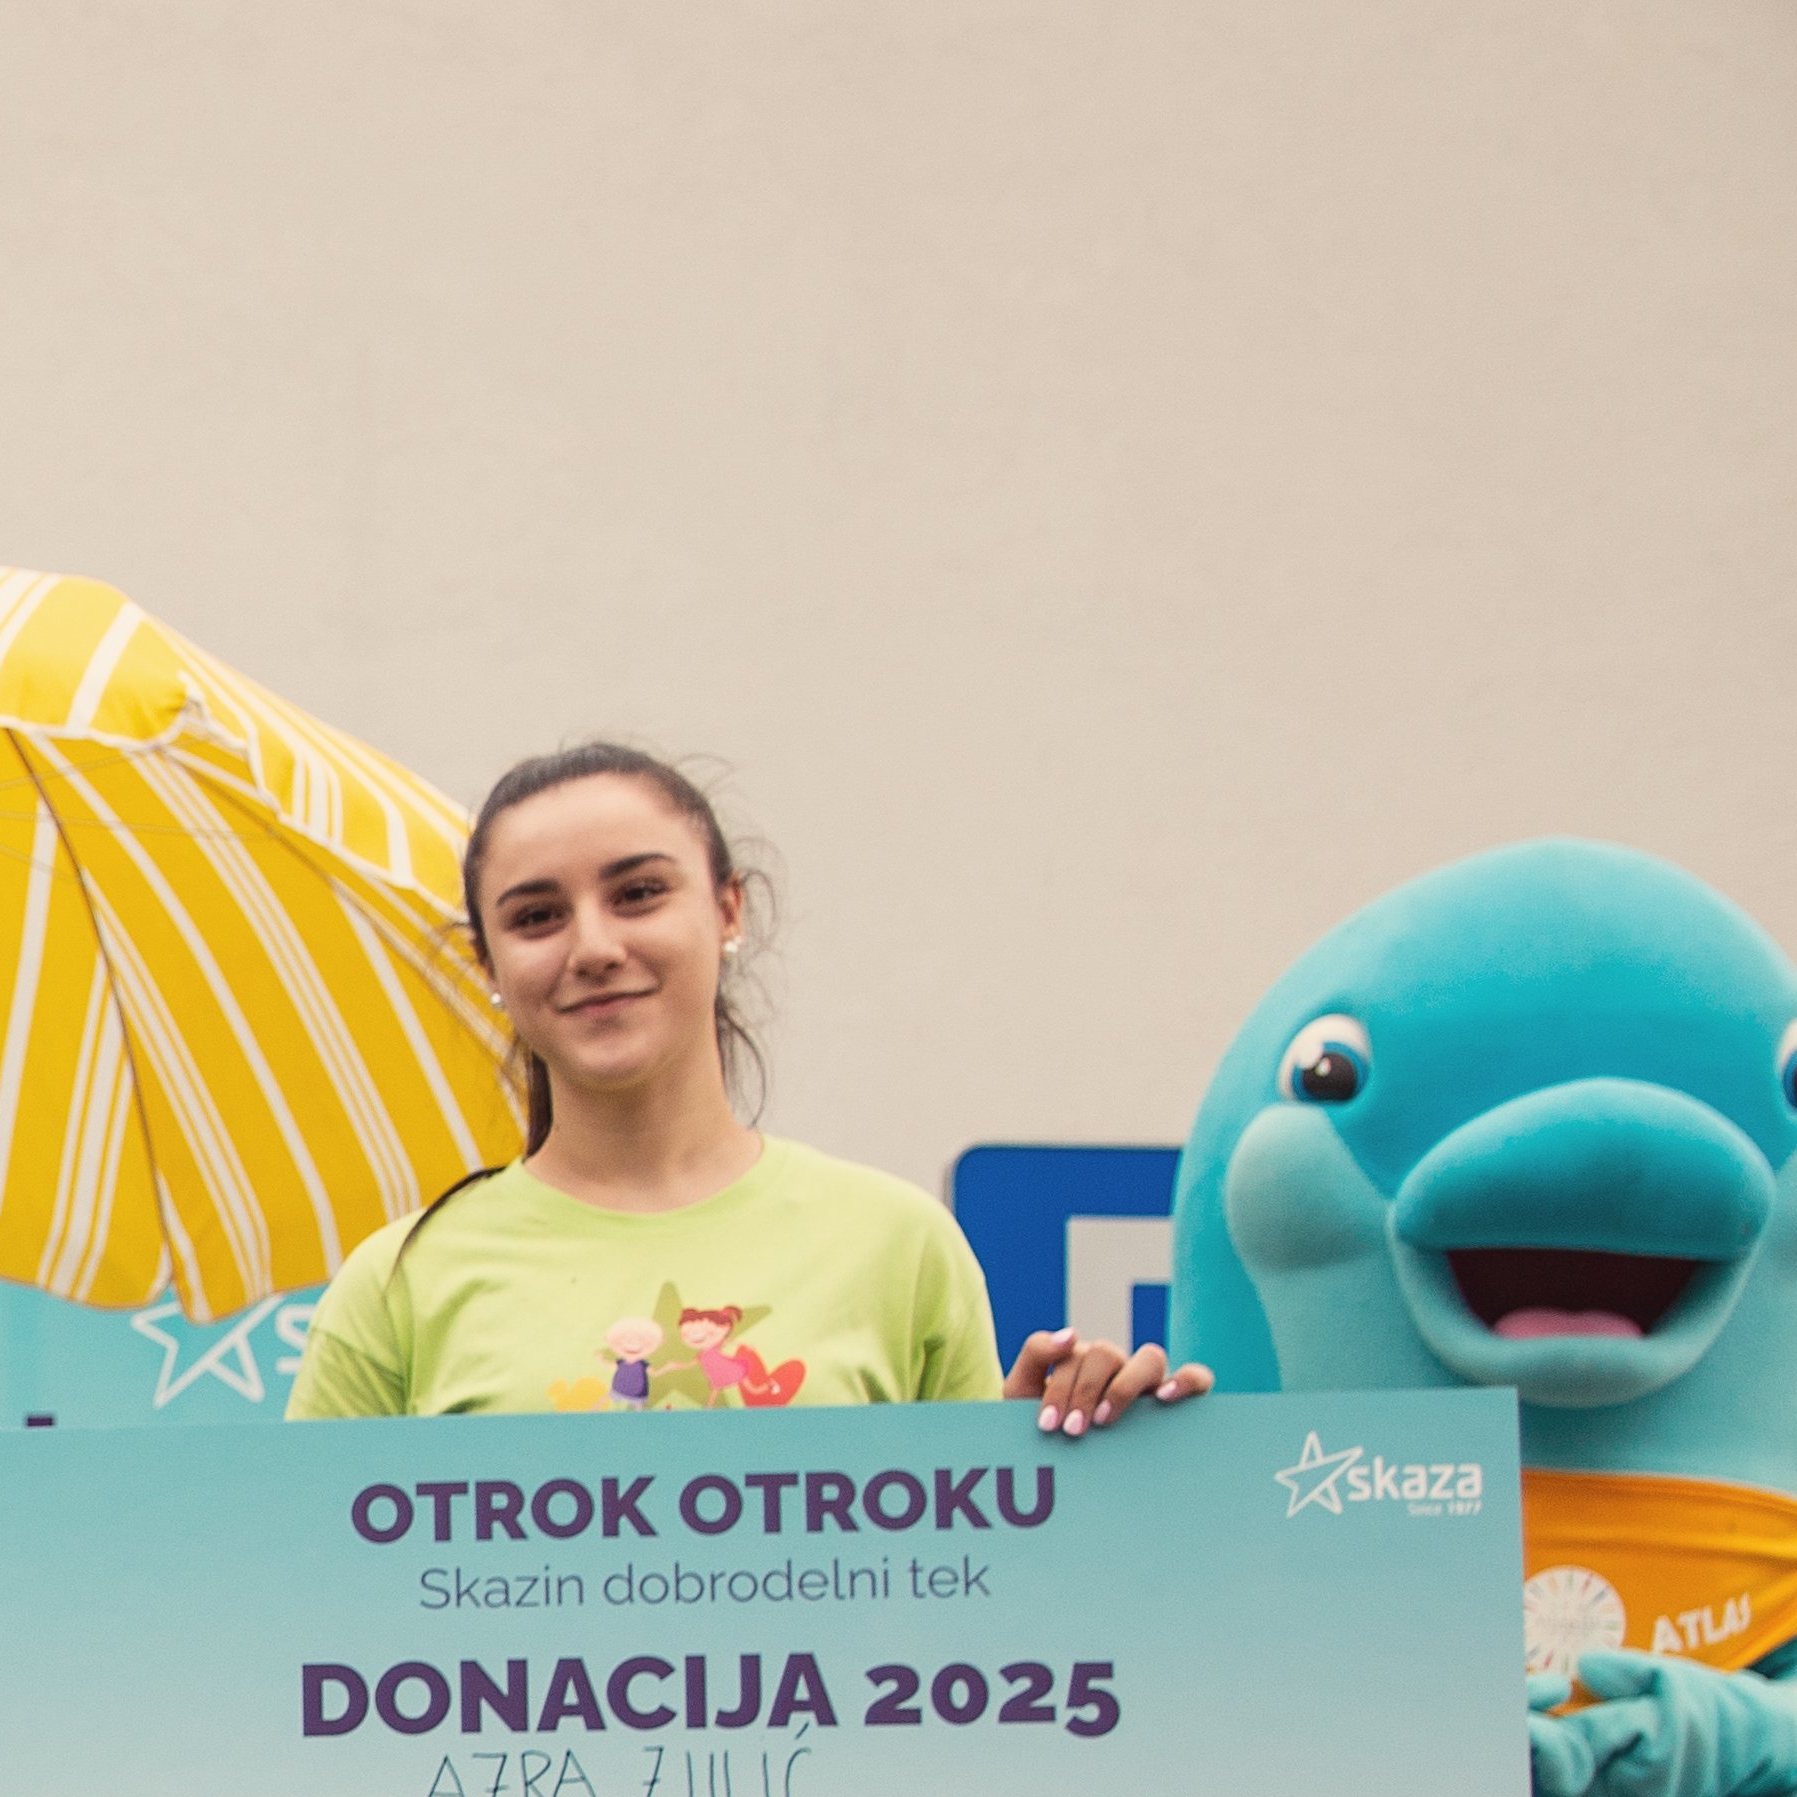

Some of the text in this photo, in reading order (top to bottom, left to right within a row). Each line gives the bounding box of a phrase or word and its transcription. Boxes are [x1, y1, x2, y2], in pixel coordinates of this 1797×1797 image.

[350, 1465, 1057, 1545] OTROK OTROKU
[1347, 1455, 1483, 1501] skaza
[420, 1554, 991, 1610] Skazin dobrodelni tek
[301, 1651, 1123, 1740] DONACIJA 2025
